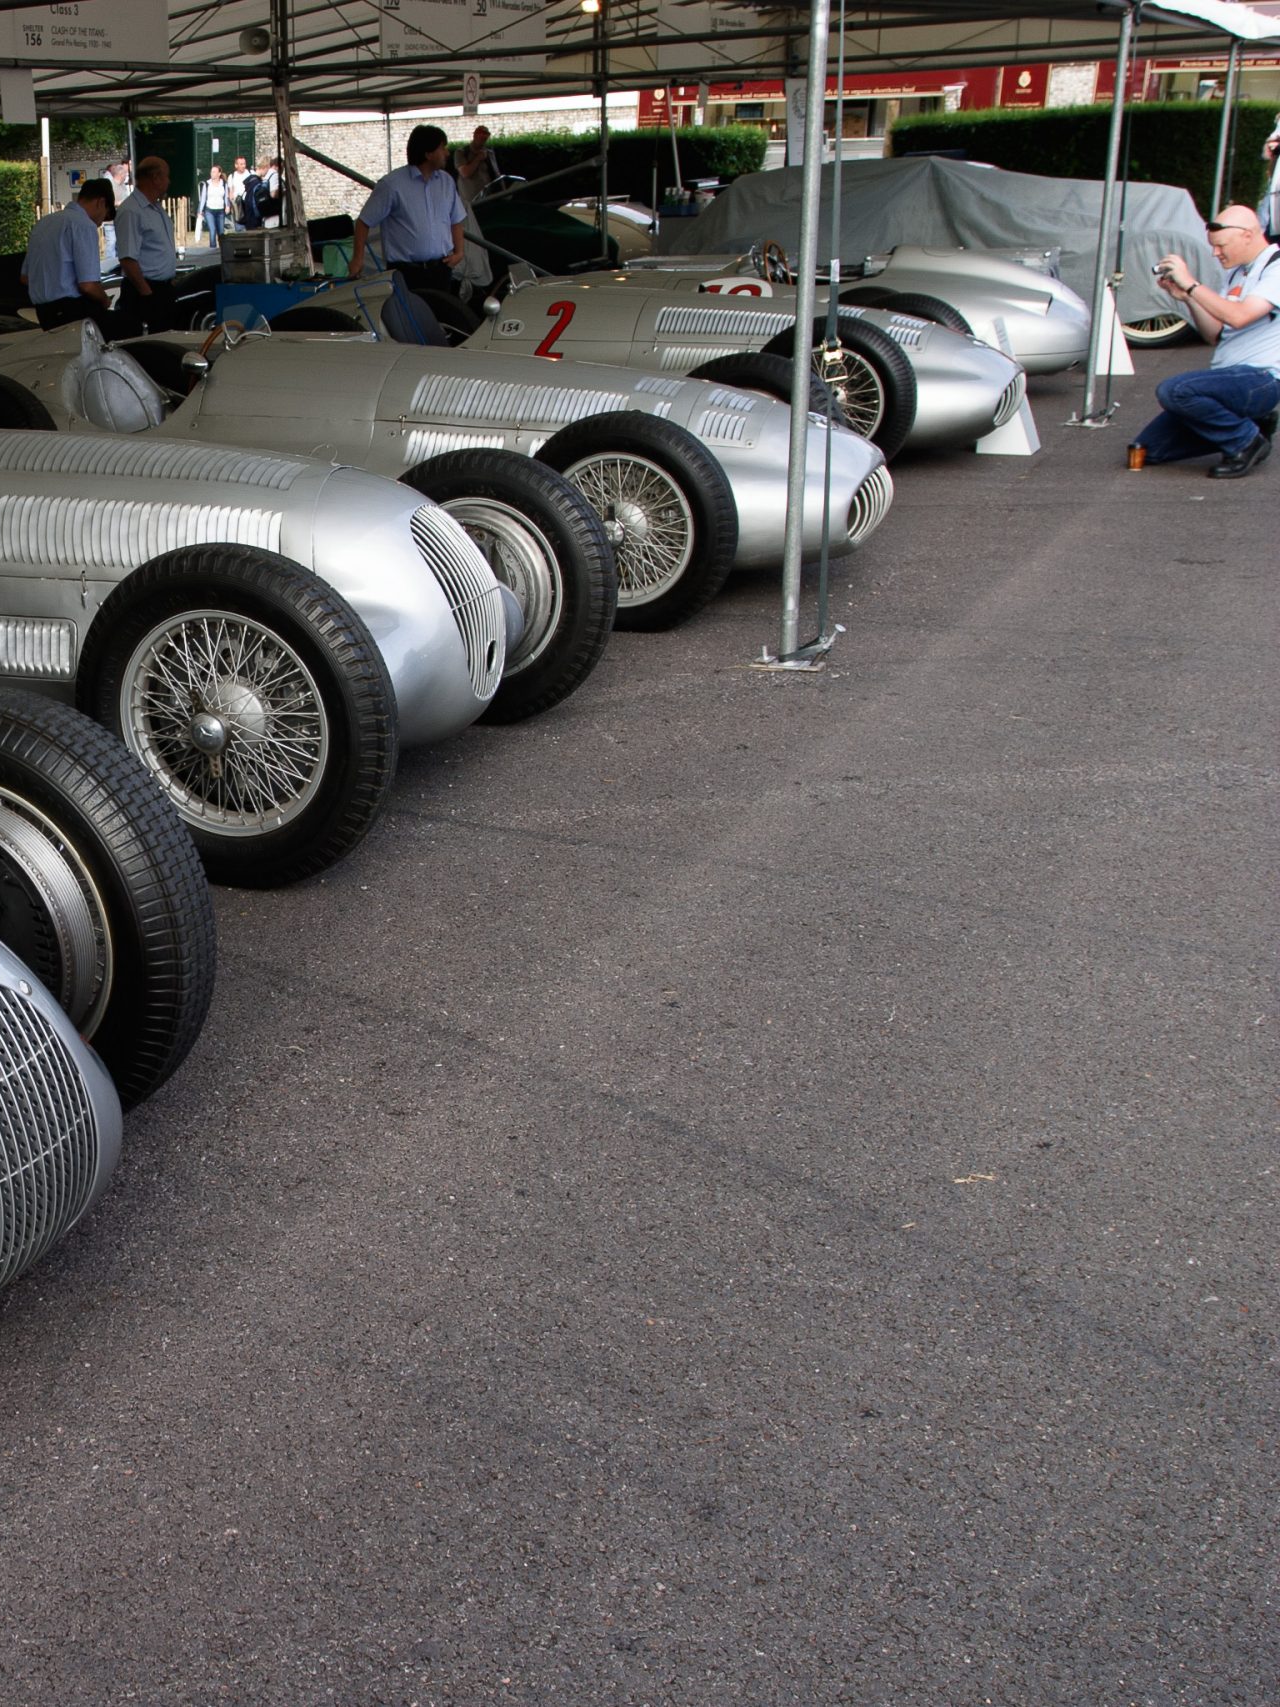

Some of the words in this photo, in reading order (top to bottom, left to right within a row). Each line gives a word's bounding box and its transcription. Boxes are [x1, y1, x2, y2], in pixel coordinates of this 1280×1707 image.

[73, 4, 79, 16] 3
[24, 33, 42, 46] 156
[501, 322, 520, 332] 154
[533, 300, 577, 359] 2
